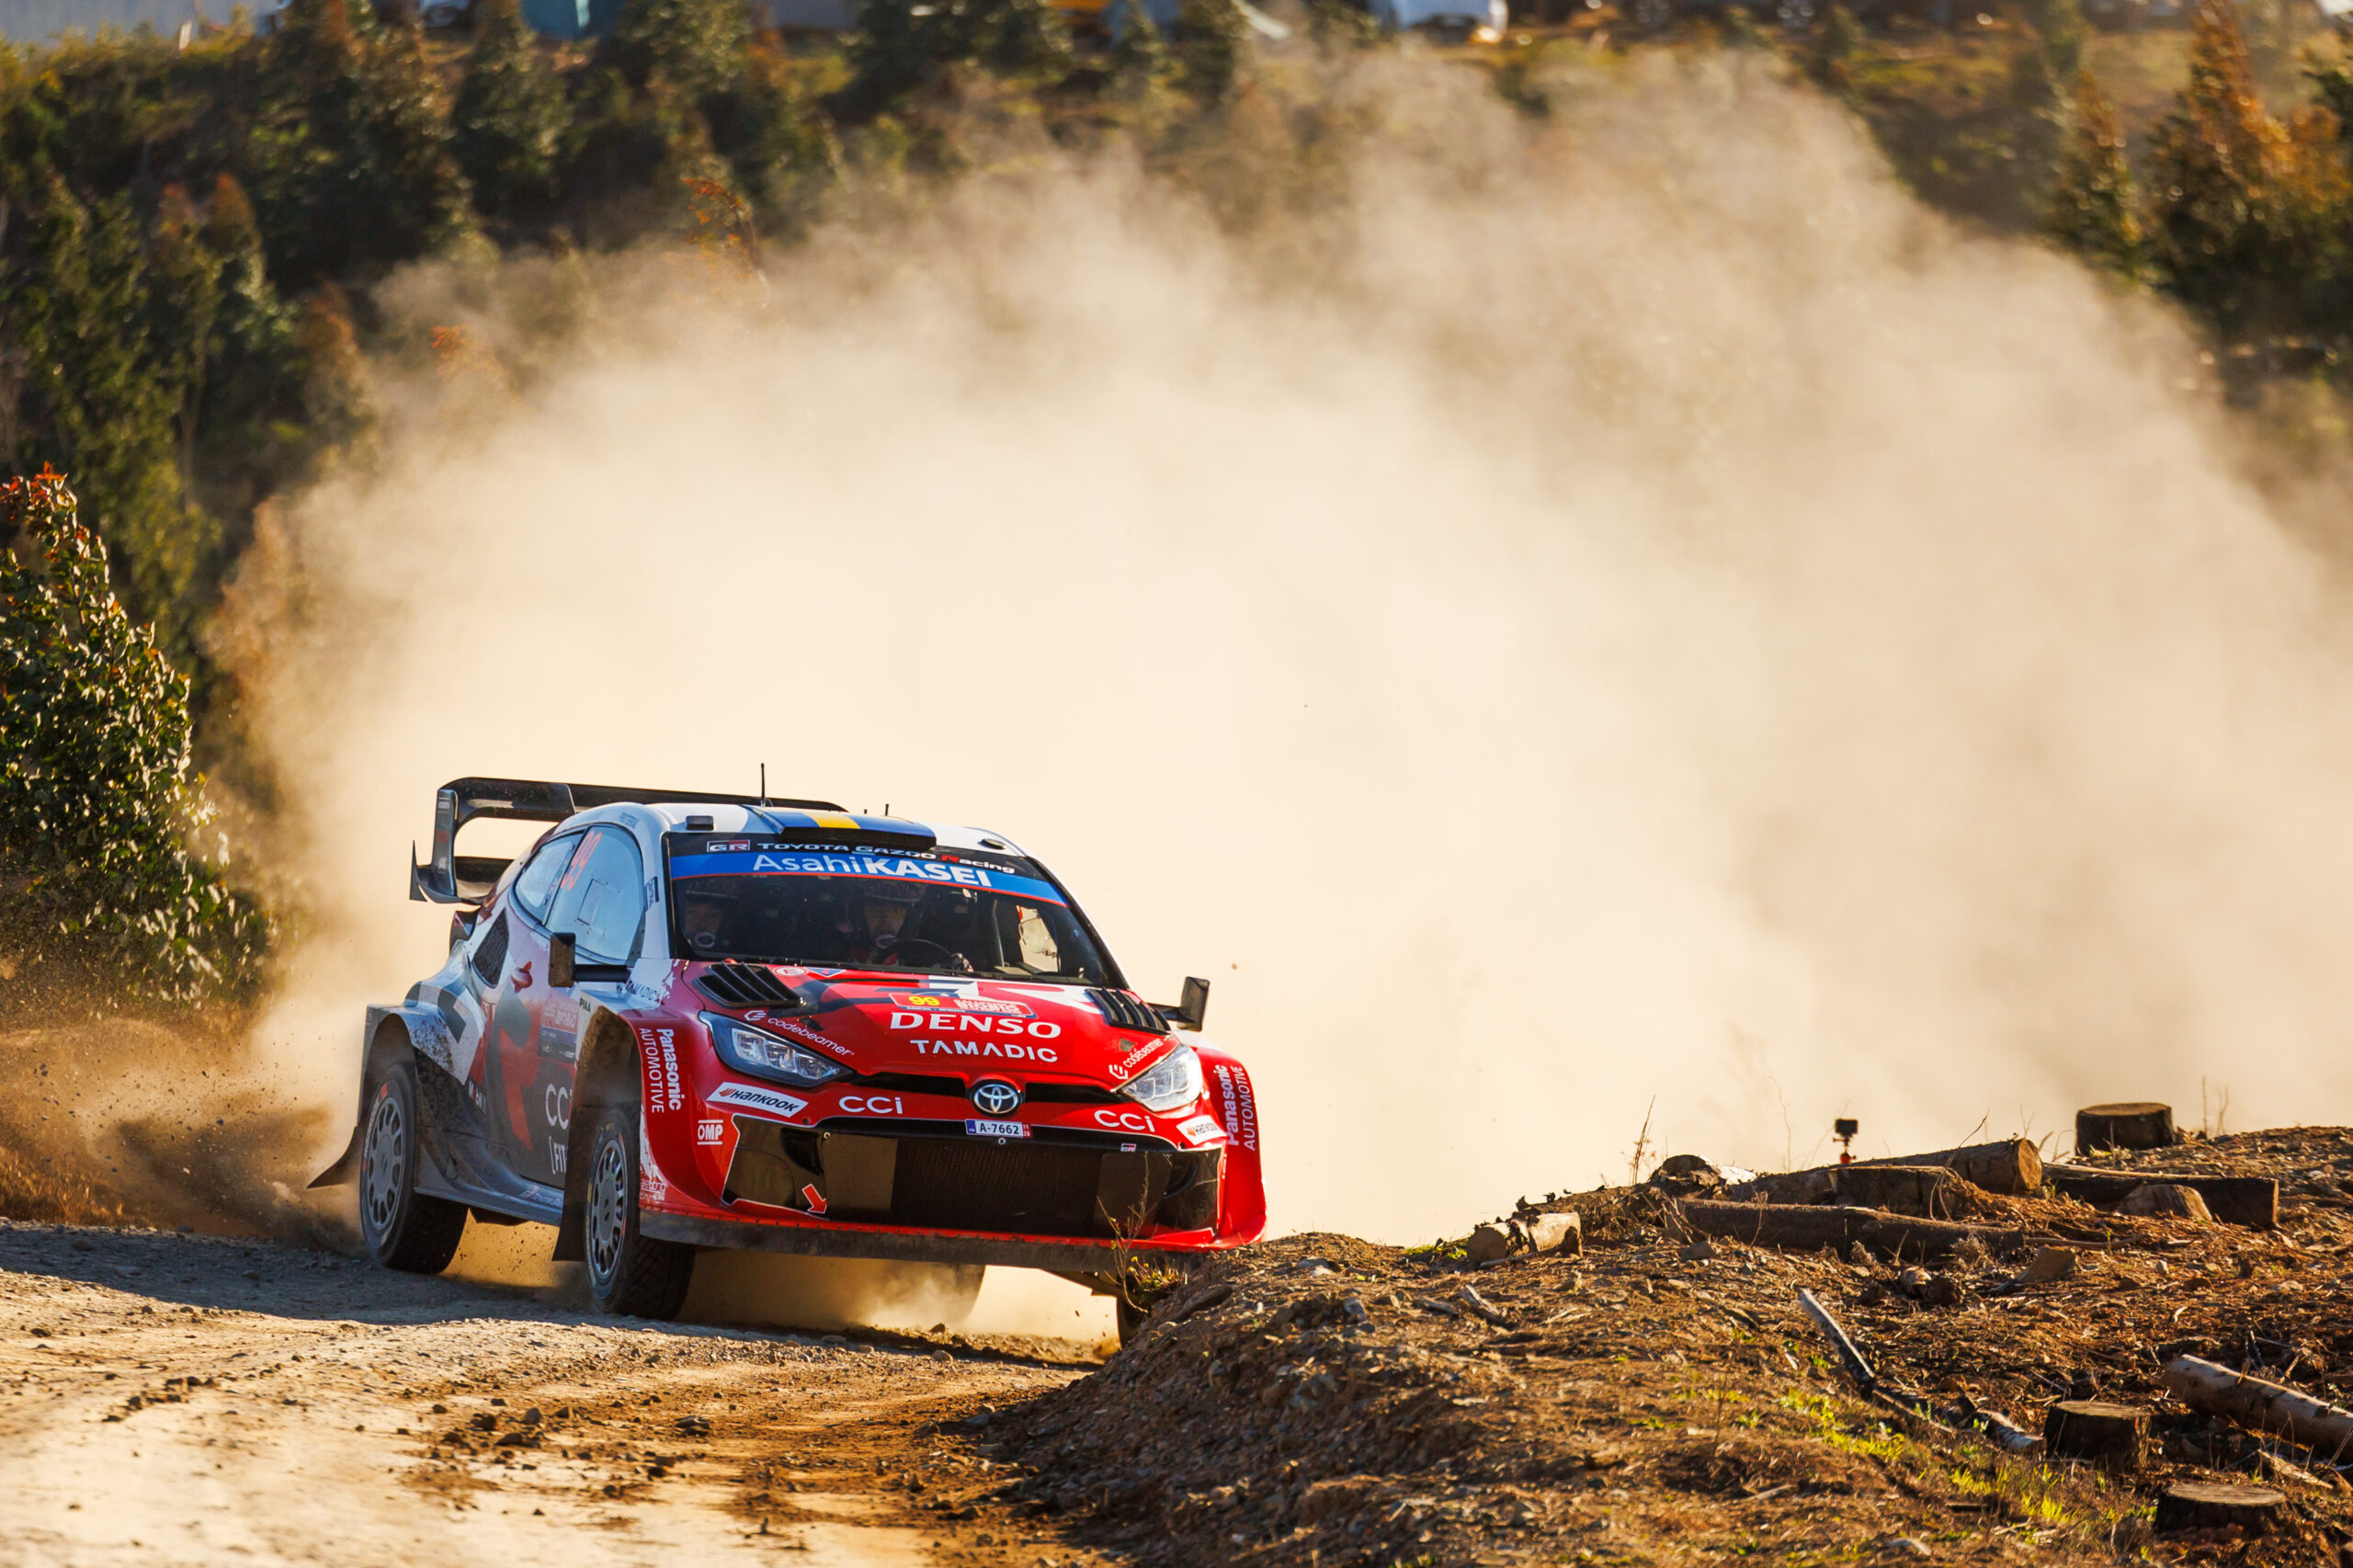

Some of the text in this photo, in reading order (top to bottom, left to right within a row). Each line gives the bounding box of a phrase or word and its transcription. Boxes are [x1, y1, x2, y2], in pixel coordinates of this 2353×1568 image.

[708, 842, 749, 852] GR
[756, 843, 849, 851] TOYOTA
[908, 995, 940, 1006] 99
[767, 1017, 852, 1056] codebeamer
[889, 1011, 1062, 1040] DENSO
[909, 1040, 1058, 1062] TAMADIC
[639, 1028, 665, 1113] AUTOMOTIVE
[656, 1028, 686, 1111] Panasonic
[1213, 1064, 1240, 1146] Panasonic
[1230, 1065, 1256, 1152] AUTOMOTIVE
[697, 1124, 724, 1142] OMP
[980, 1122, 1019, 1135] A-7662
